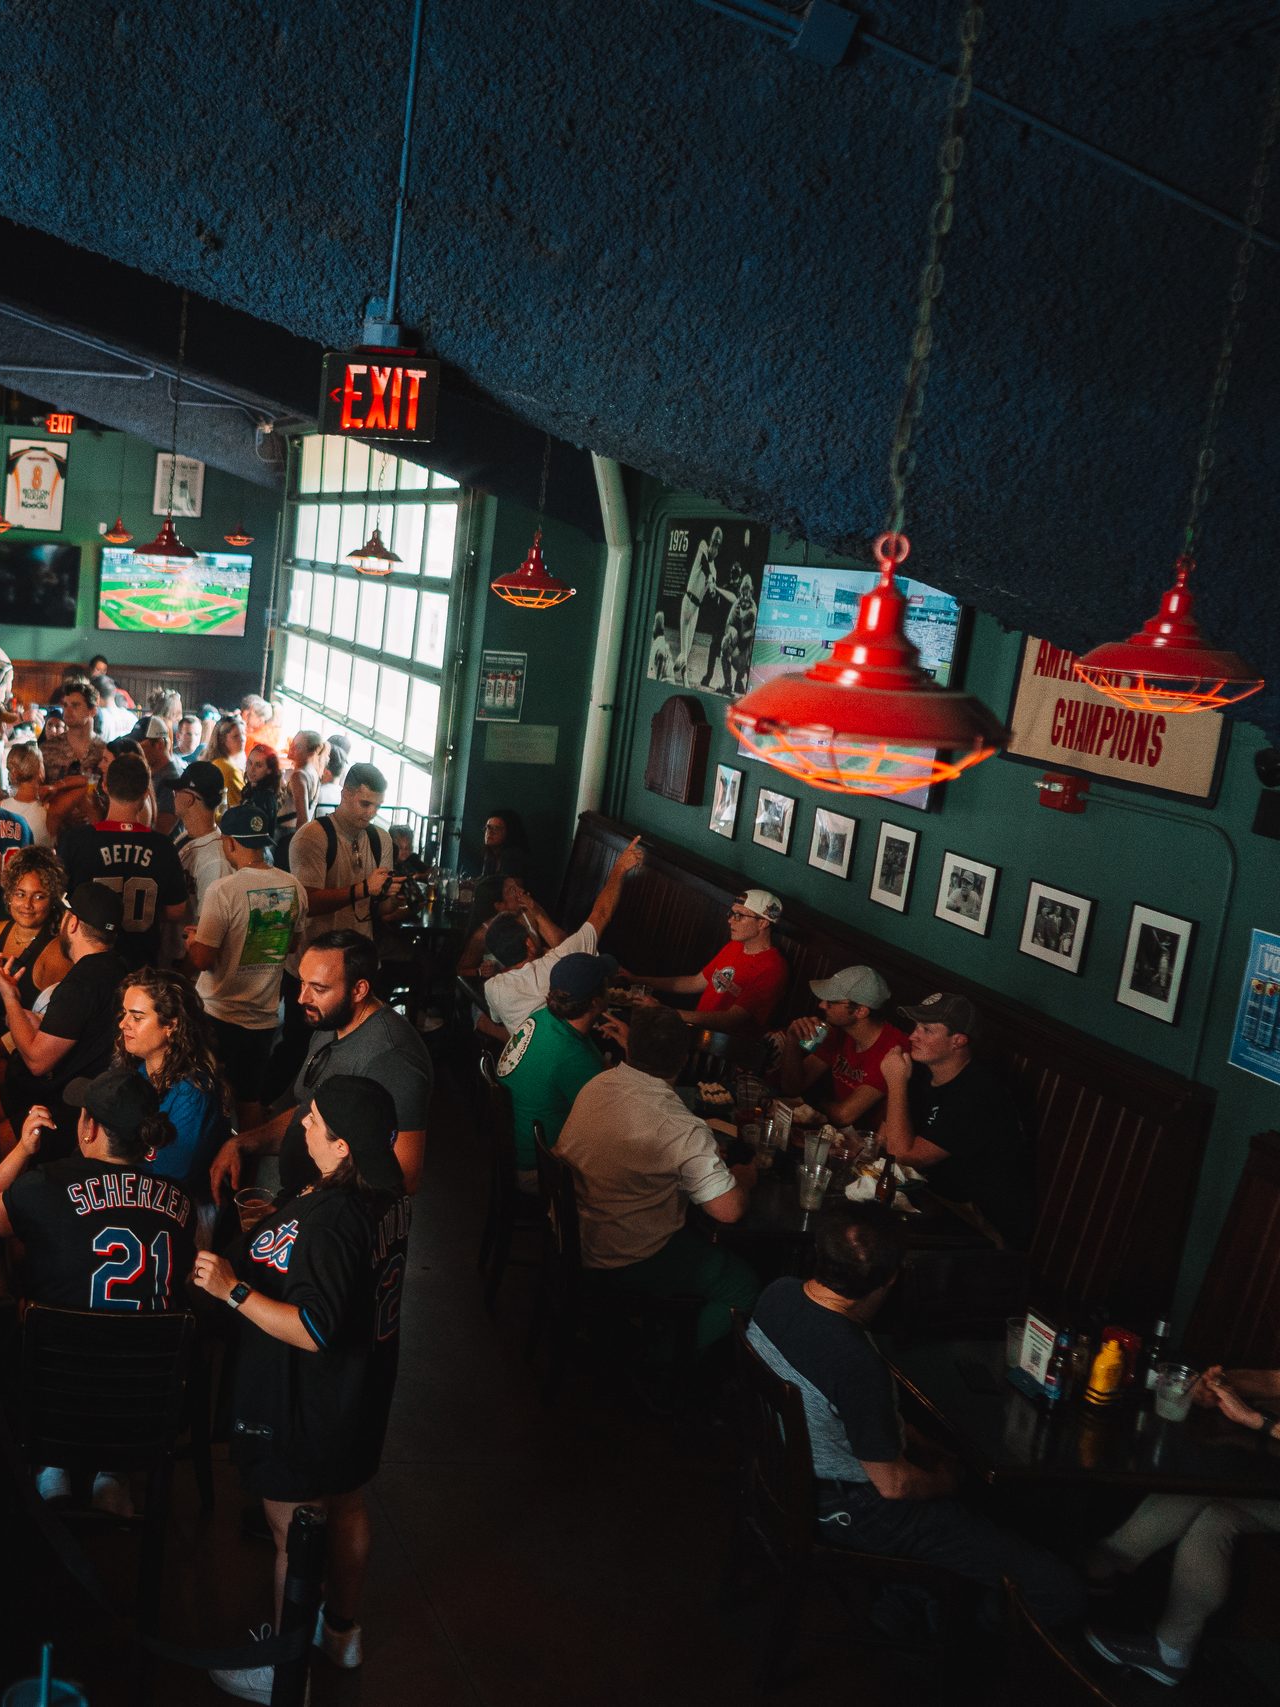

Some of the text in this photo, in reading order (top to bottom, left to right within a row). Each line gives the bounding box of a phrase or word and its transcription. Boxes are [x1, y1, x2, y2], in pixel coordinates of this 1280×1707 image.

[341, 364, 427, 431] EXIT
[49, 414, 74, 434] EXIT
[32, 465, 43, 490] 8
[668, 529, 689, 552] 1975
[1050, 697, 1167, 768] CHAMPIONS
[99, 844, 153, 868] BETTS
[67, 1173, 191, 1228] SCHERZER
[90, 1227, 173, 1311] 21
